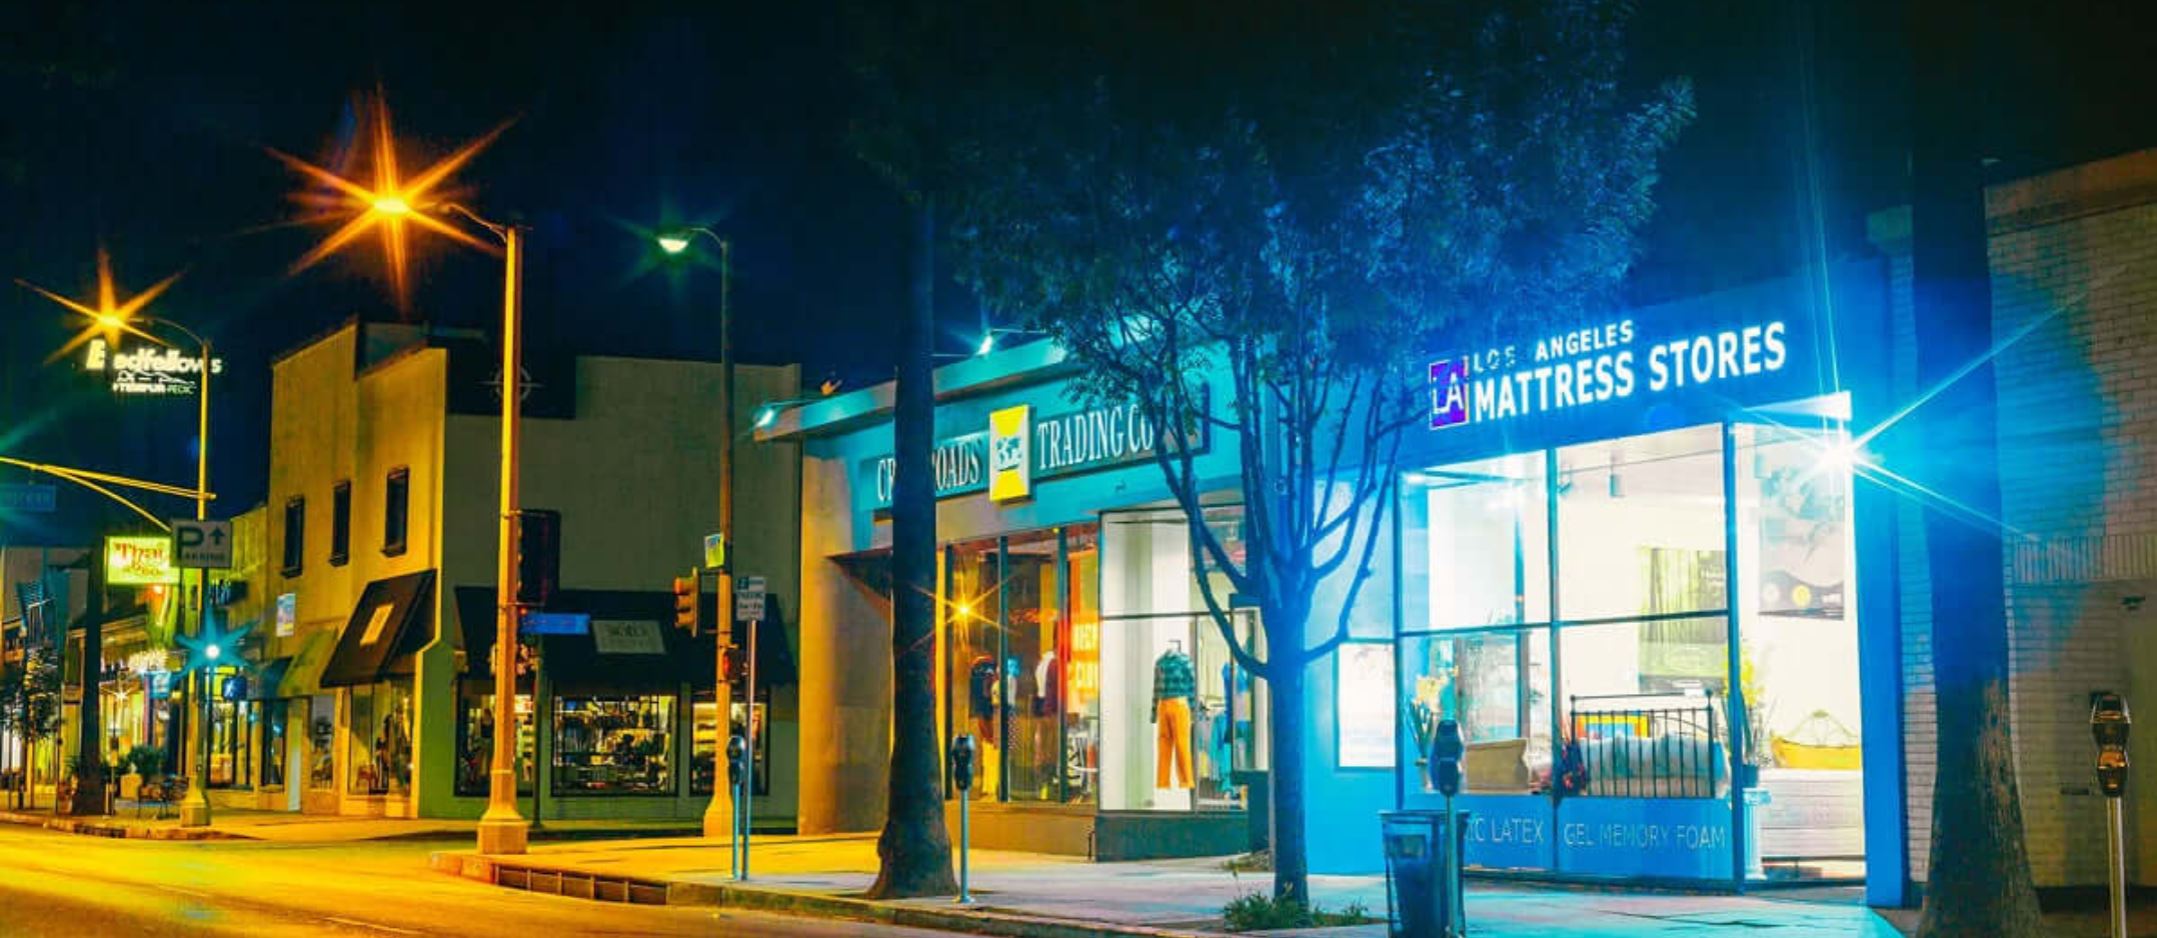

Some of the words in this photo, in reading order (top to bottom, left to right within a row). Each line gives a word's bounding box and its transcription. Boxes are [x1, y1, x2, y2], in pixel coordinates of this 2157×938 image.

[1534, 319, 1635, 362] ANGELES
[1473, 350, 1635, 423] MATTRESS
[1650, 321, 1787, 392] STORES
[1037, 405, 1125, 470] TRADING
[1491, 817, 1545, 844] LATEX
[1563, 823, 1595, 846] GEL
[1676, 825, 1727, 850] FOAM
